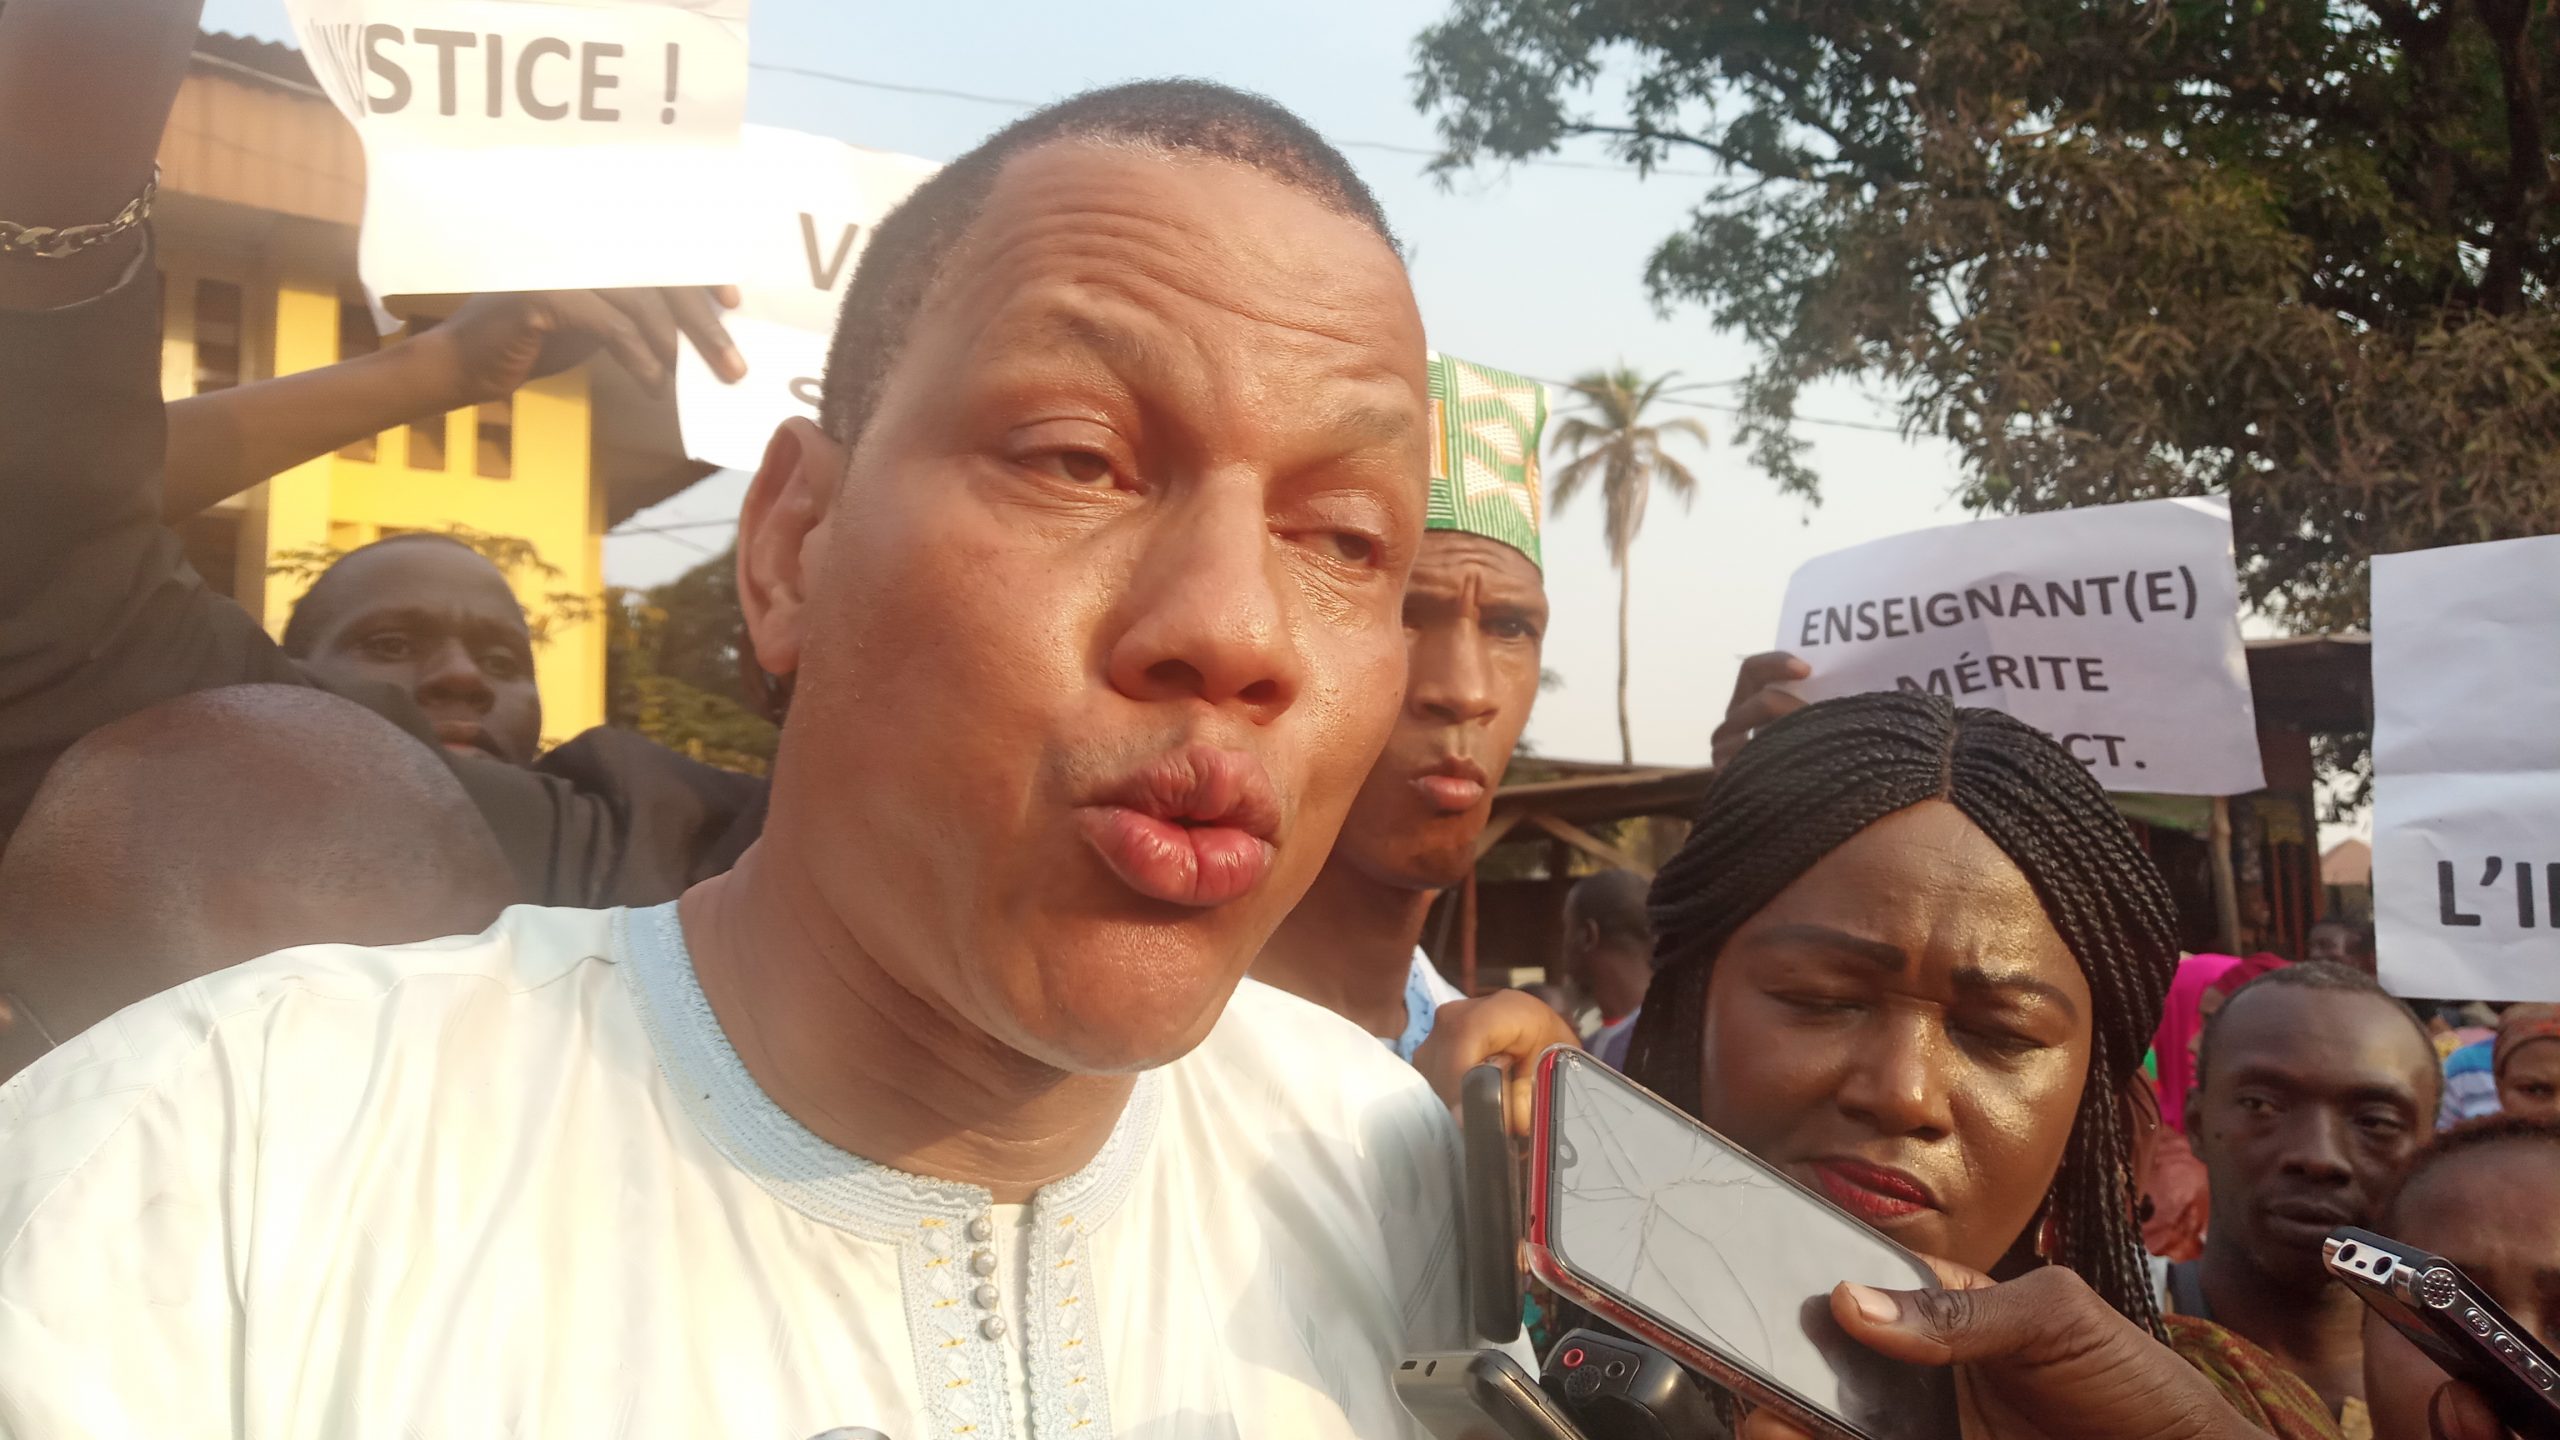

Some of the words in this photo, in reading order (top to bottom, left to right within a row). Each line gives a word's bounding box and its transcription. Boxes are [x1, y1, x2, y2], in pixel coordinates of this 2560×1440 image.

[1800, 565, 2198, 648] ENSEIGNANT(E)
[1895, 651, 2110, 698] MÉRITE
[2056, 732, 2147, 769] CT.
